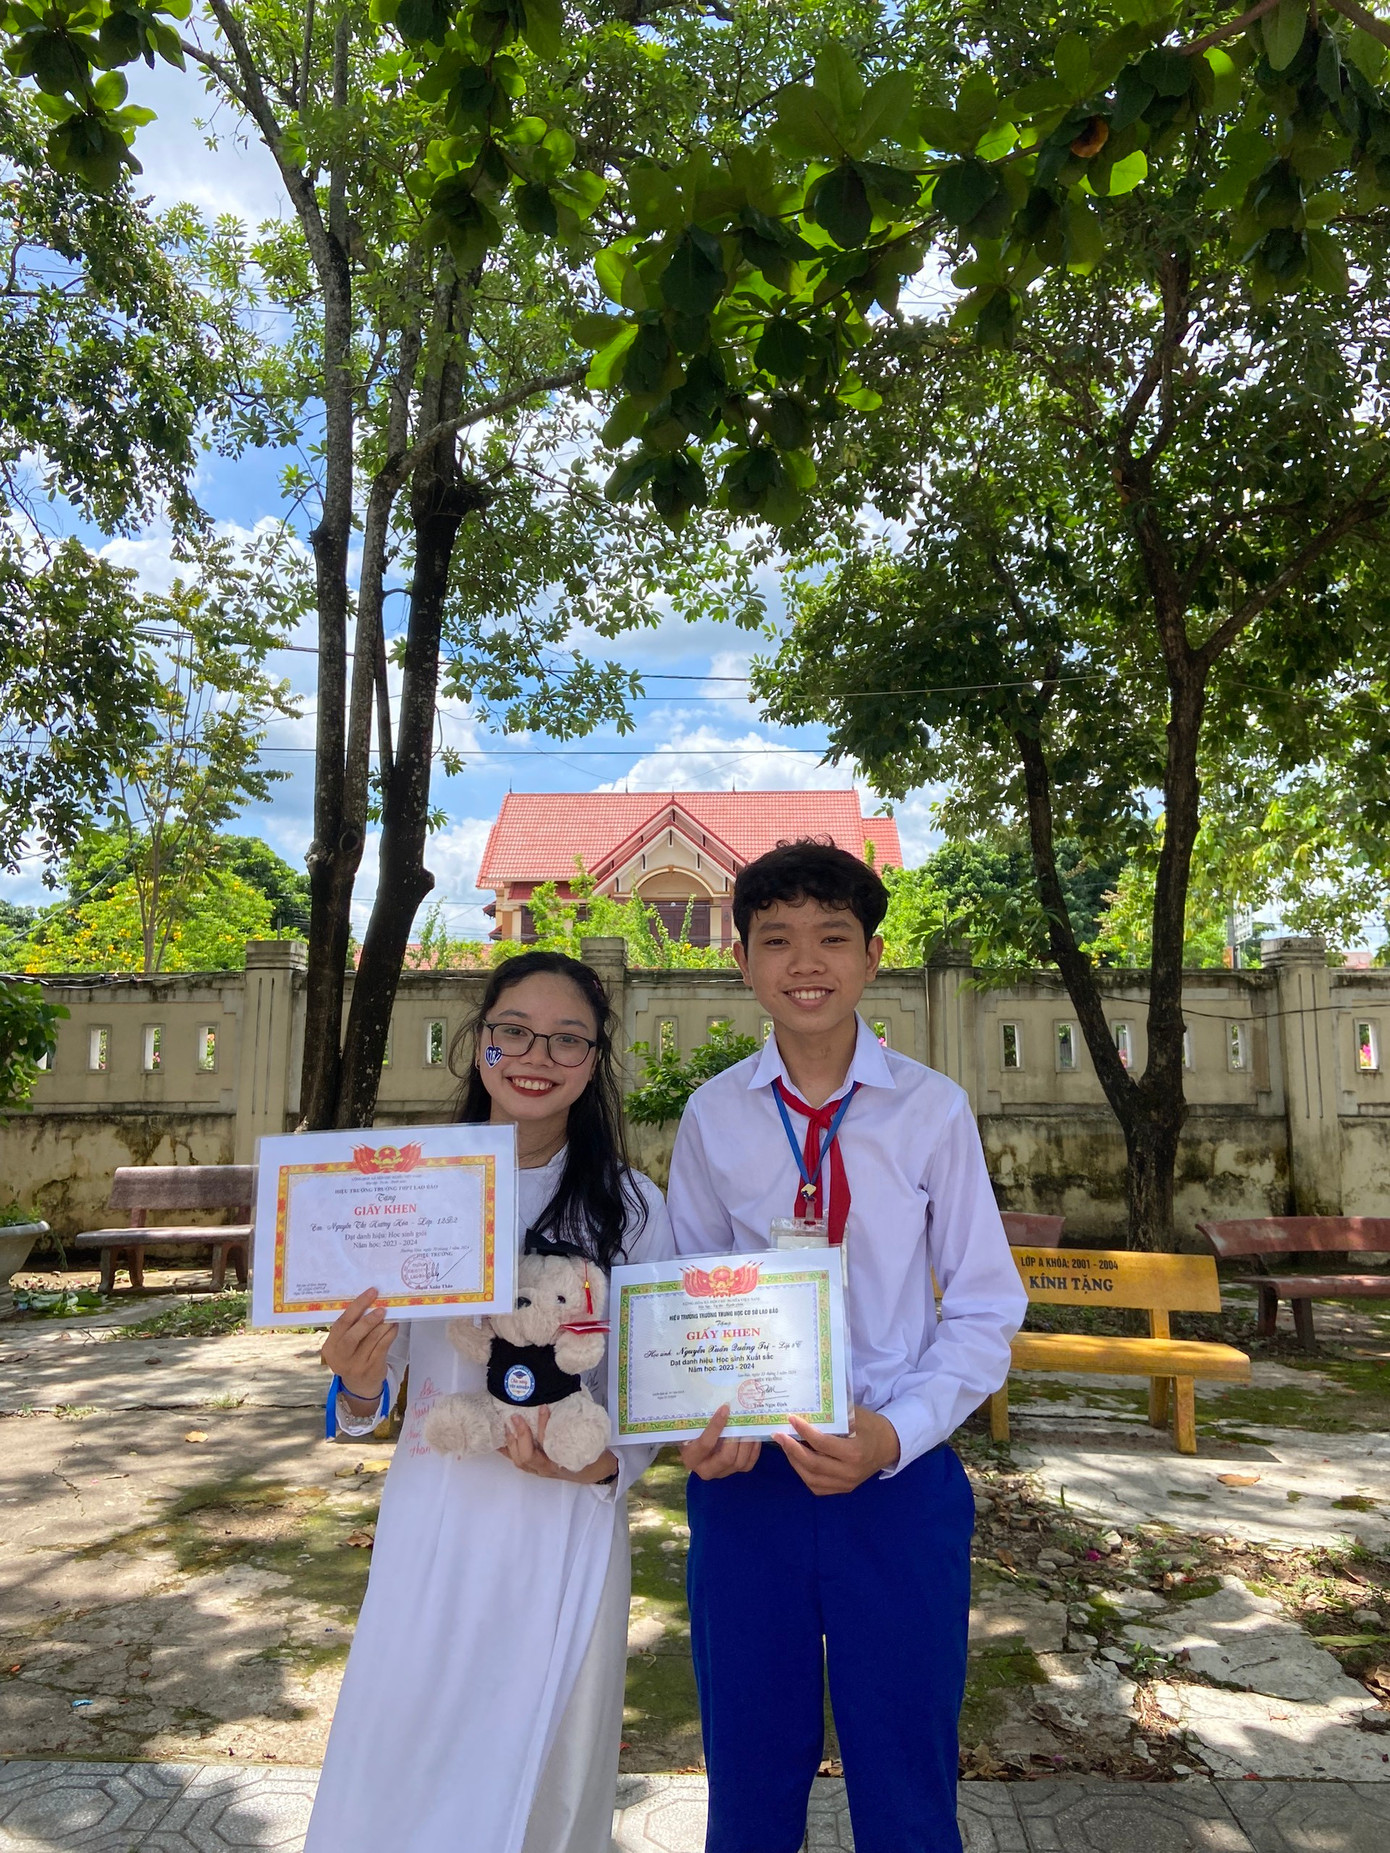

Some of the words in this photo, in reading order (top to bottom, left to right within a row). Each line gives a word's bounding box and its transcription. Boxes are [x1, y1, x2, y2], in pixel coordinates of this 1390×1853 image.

[354, 1203, 382, 1216] GIẤY
[384, 1203, 417, 1215] KHEN
[402, 1239, 418, 1247] 2024
[1021, 1255, 1036, 1267] LỚP
[1038, 1257, 1045, 1267] A
[1046, 1255, 1070, 1269] KHÓA:
[1071, 1258, 1091, 1269] 2001
[1099, 1259, 1119, 1270] 2004
[1029, 1272, 1068, 1290] KÍNH
[1071, 1274, 1114, 1295] TẶNG
[686, 1327, 719, 1341] GIẤY
[723, 1327, 761, 1339] KHEN
[682, 1357, 698, 1366] danh
[716, 1356, 729, 1364] Học
[730, 1354, 745, 1362] sinh
[746, 1352, 761, 1361] Xuất
[688, 1365, 703, 1373] Năm
[718, 1363, 735, 1371] 2023
[740, 1362, 755, 1370] 2024
